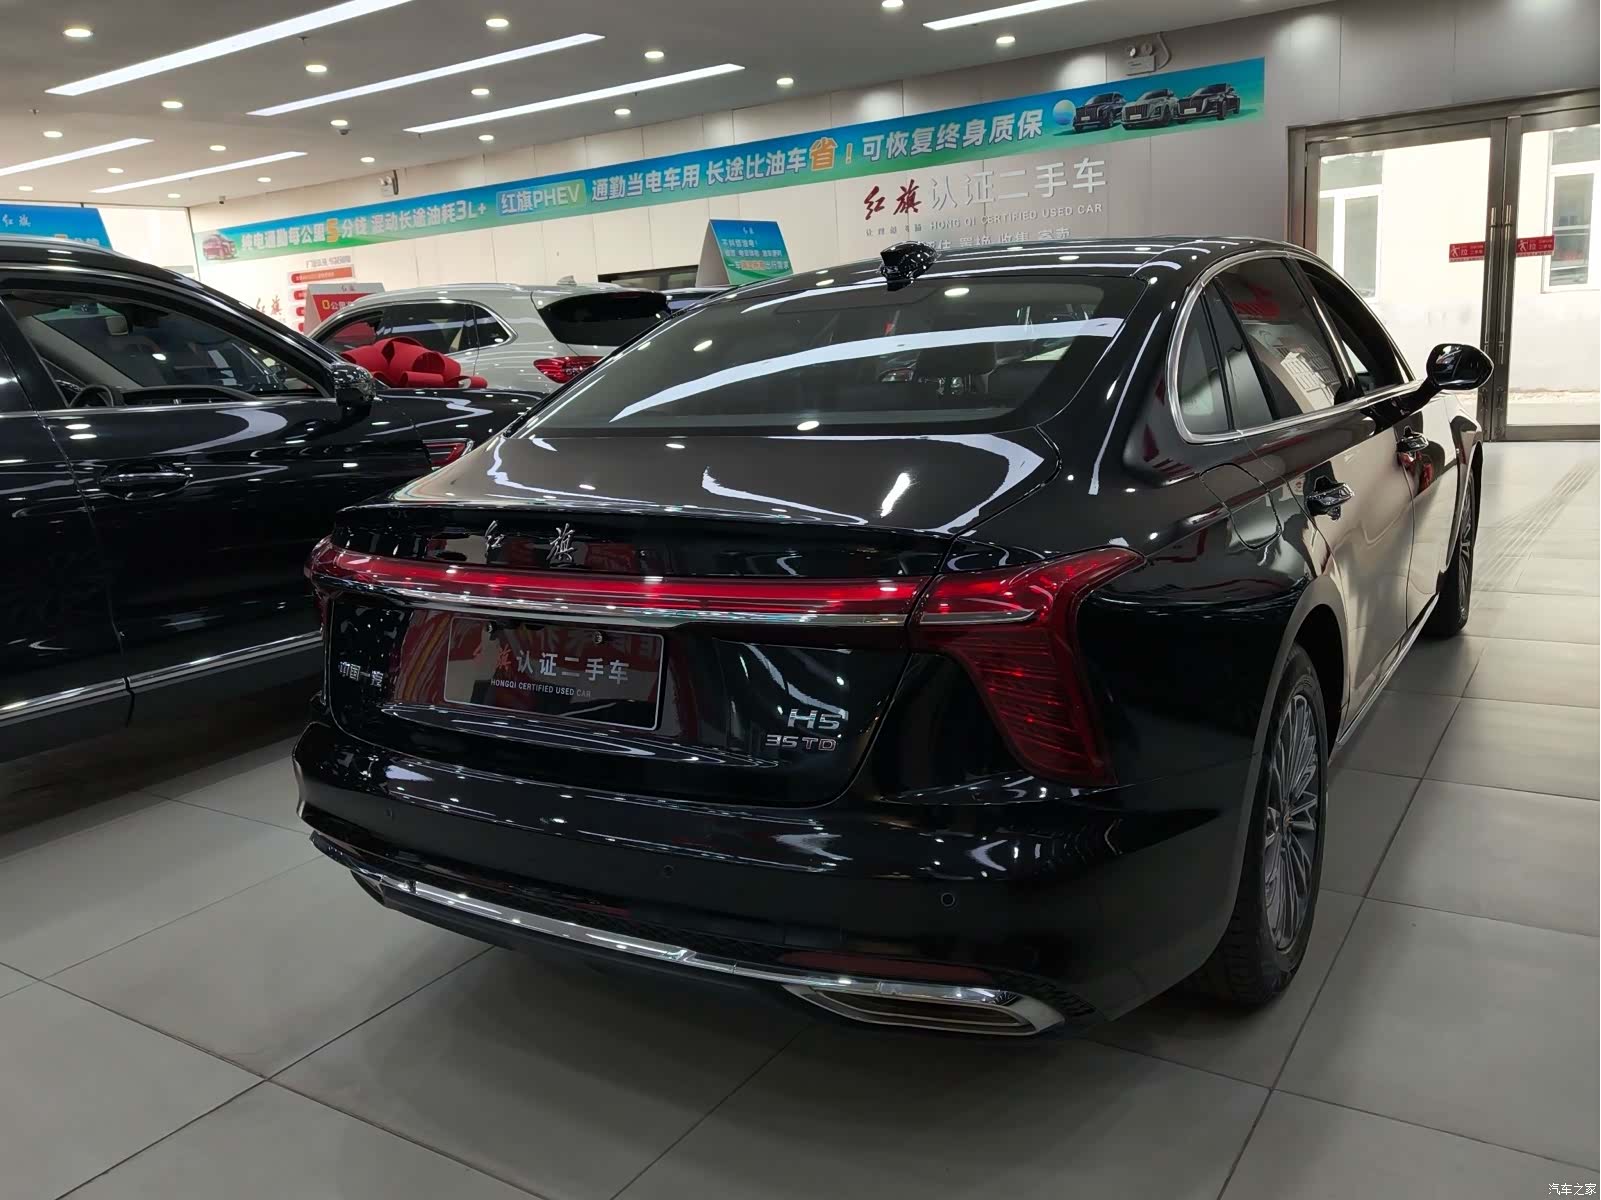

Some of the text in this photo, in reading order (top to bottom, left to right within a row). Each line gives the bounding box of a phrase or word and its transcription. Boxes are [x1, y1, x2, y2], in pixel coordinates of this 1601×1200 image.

[500, 183, 581, 214] 红旗PHEV
[591, 163, 701, 202] 通勤当电车用
[862, 108, 1044, 162] 可恢复终身质保
[930, 219, 961, 231] HONG
[980, 208, 1038, 226] CERTIFIED
[1042, 206, 1073, 218] USED
[1078, 203, 1103, 215] CAR
[484, 520, 576, 562] 红旗
[337, 660, 384, 688] 中国一汽
[490, 678, 592, 698] HONGQI CERTIFIED USED CAR
[787, 708, 842, 730] H5
[765, 734, 837, 751] 35TD
